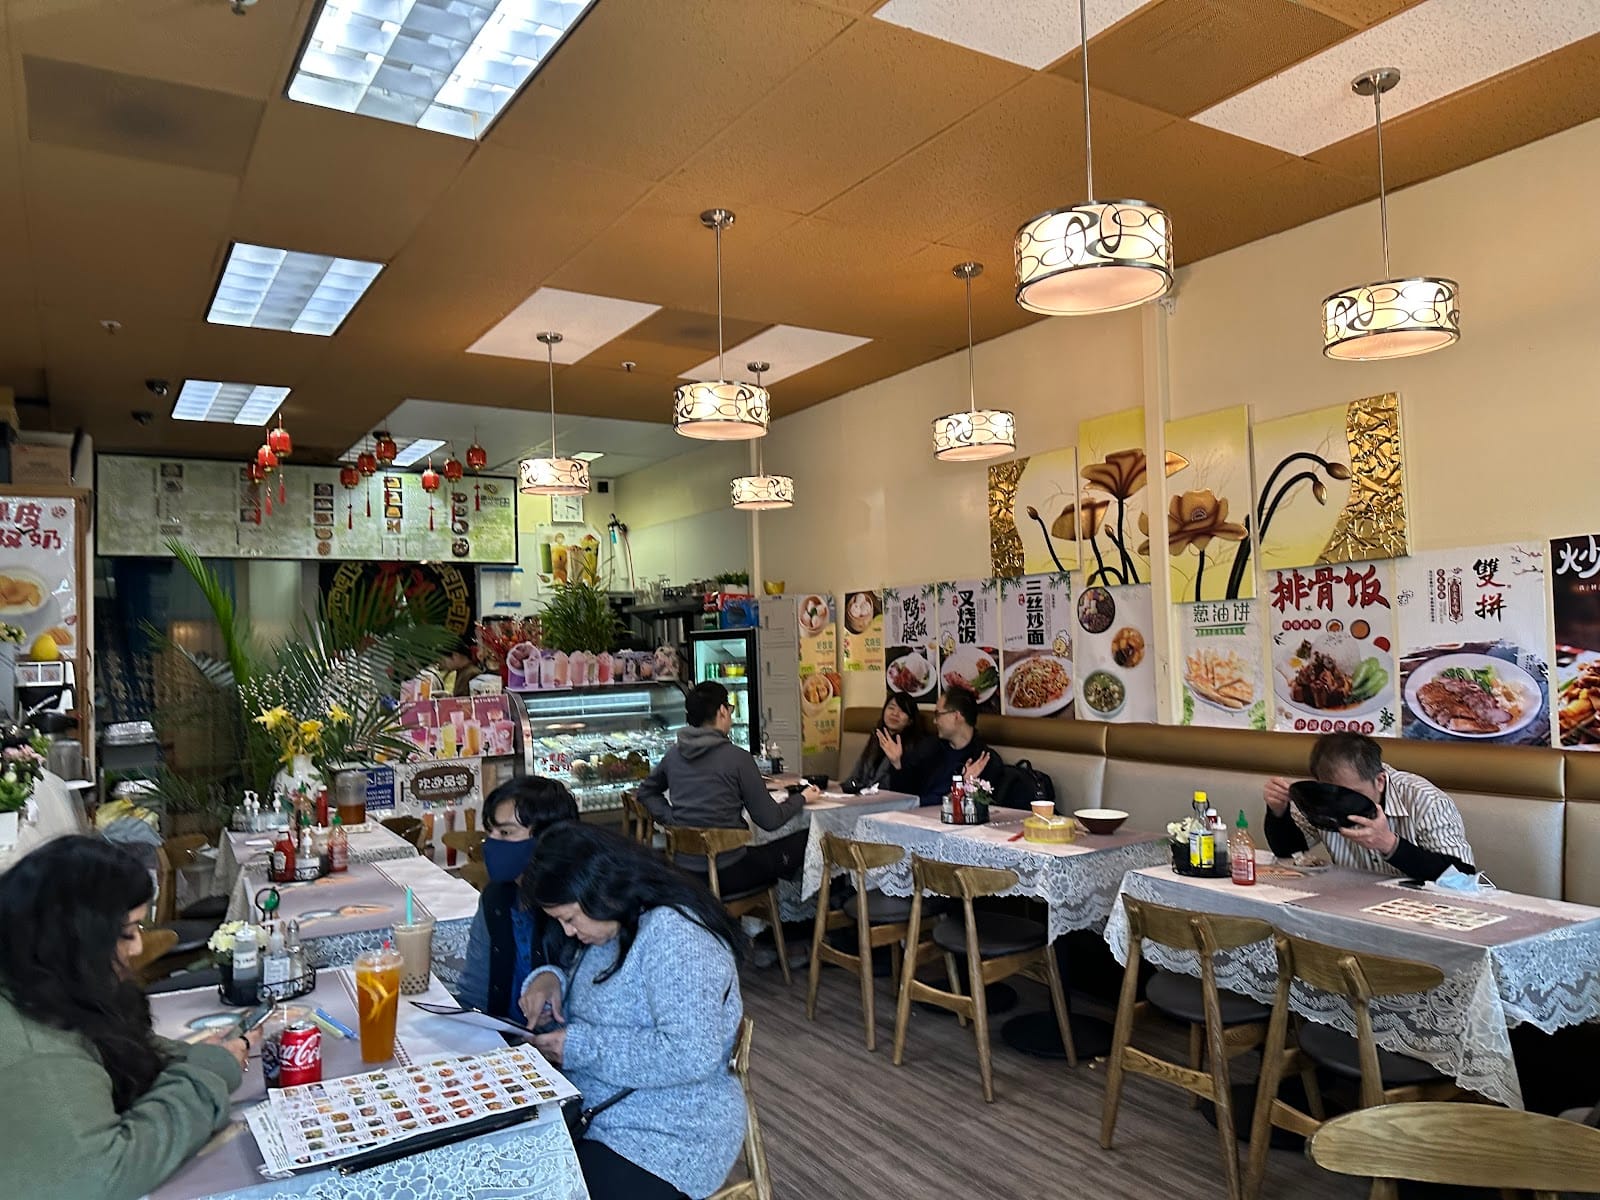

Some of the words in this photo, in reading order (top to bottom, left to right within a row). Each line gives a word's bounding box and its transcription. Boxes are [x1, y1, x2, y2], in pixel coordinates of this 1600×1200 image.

[1026, 580, 1045, 645] 三丝炒面
[1193, 602, 1251, 623] 葱油饼
[1270, 564, 1391, 614] 排骨饭
[1473, 557, 1508, 622] 雙拼
[957, 590, 976, 644] 叉烧饭
